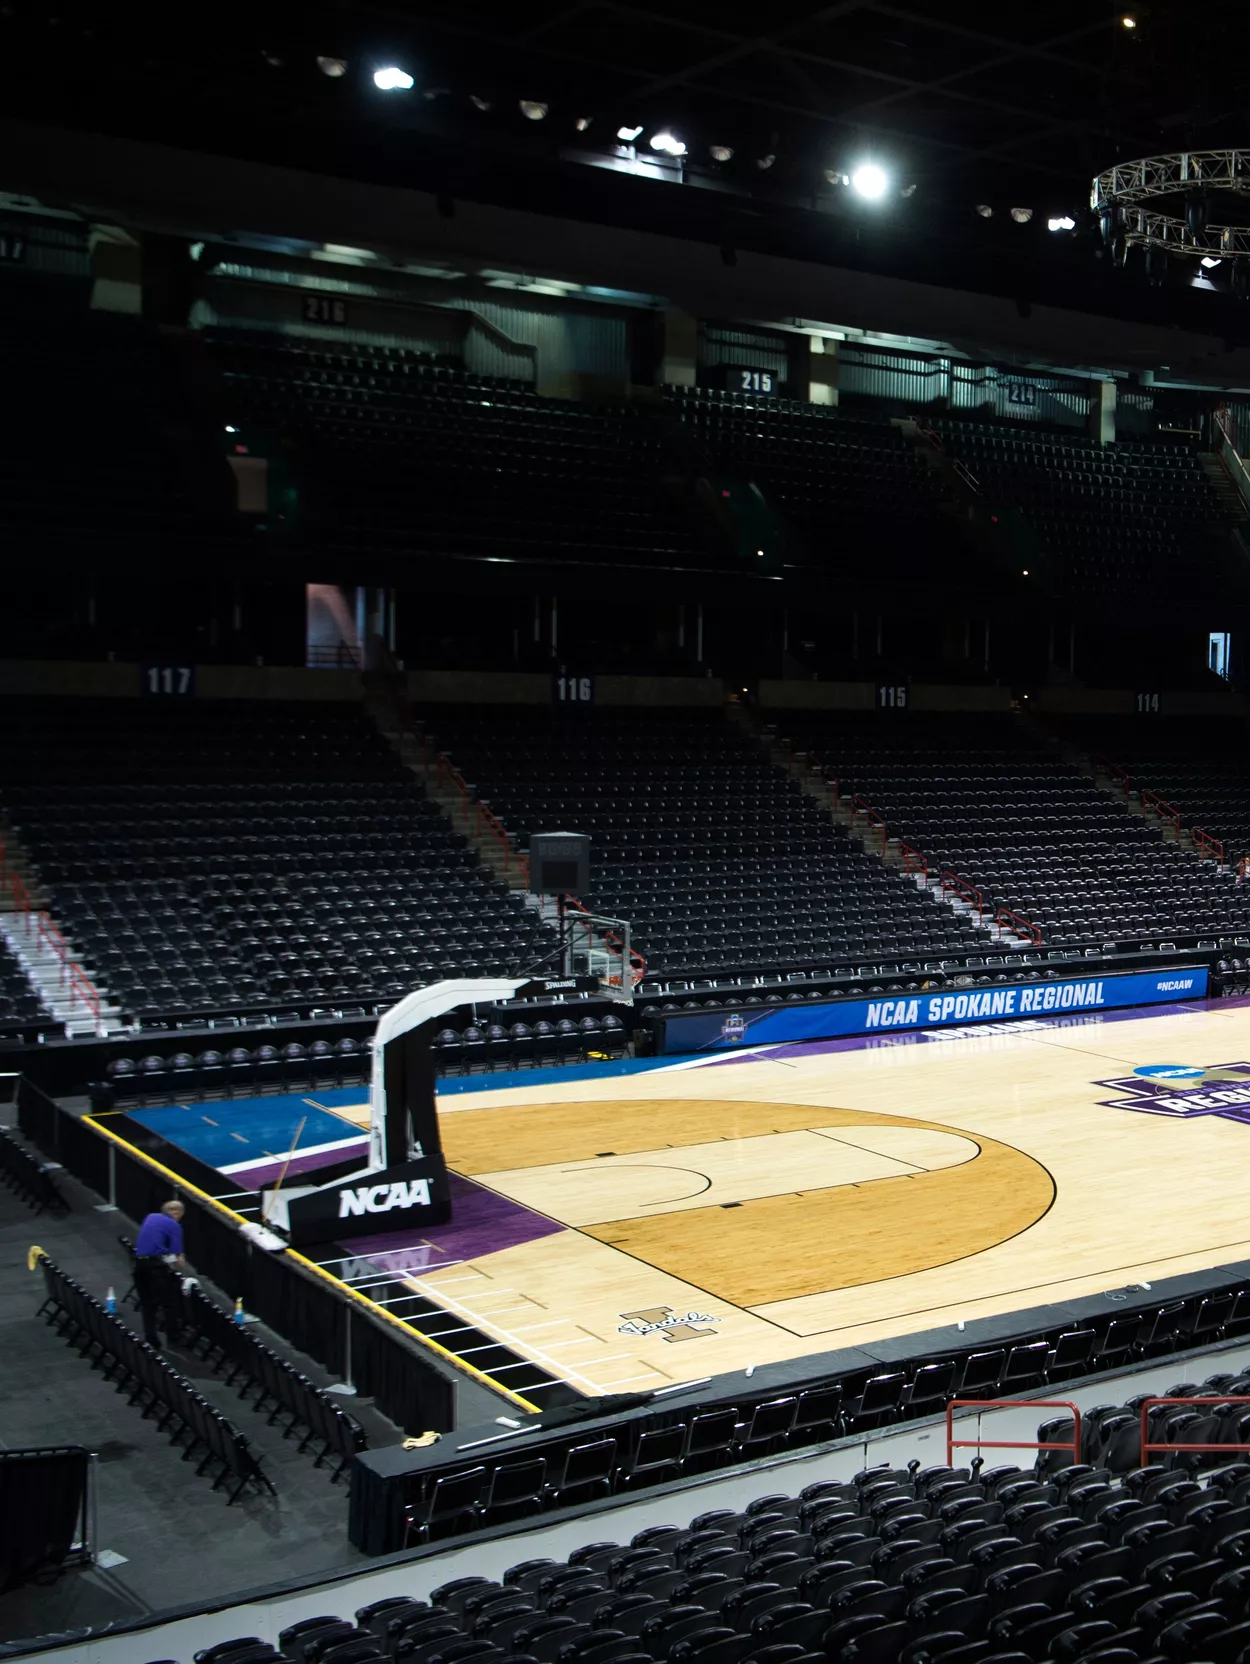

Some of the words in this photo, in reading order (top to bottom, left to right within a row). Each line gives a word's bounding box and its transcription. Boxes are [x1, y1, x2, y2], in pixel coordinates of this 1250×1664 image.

[305, 297, 346, 322] 216
[741, 371, 772, 392] 215
[1011, 384, 1035, 403] 214
[147, 667, 192, 694] 117
[557, 678, 592, 701] 116
[880, 686, 906, 708] 115
[1137, 693, 1160, 712] 114
[544, 979, 576, 991] SPALDING
[1156, 978, 1194, 992] #NCAAW
[865, 1000, 920, 1028] NCAA
[928, 992, 1015, 1022] SPOKANE
[1020, 982, 1104, 1012] REGIONAL
[338, 1178, 431, 1218] NCAA
[617, 1311, 722, 1336] Vandals
